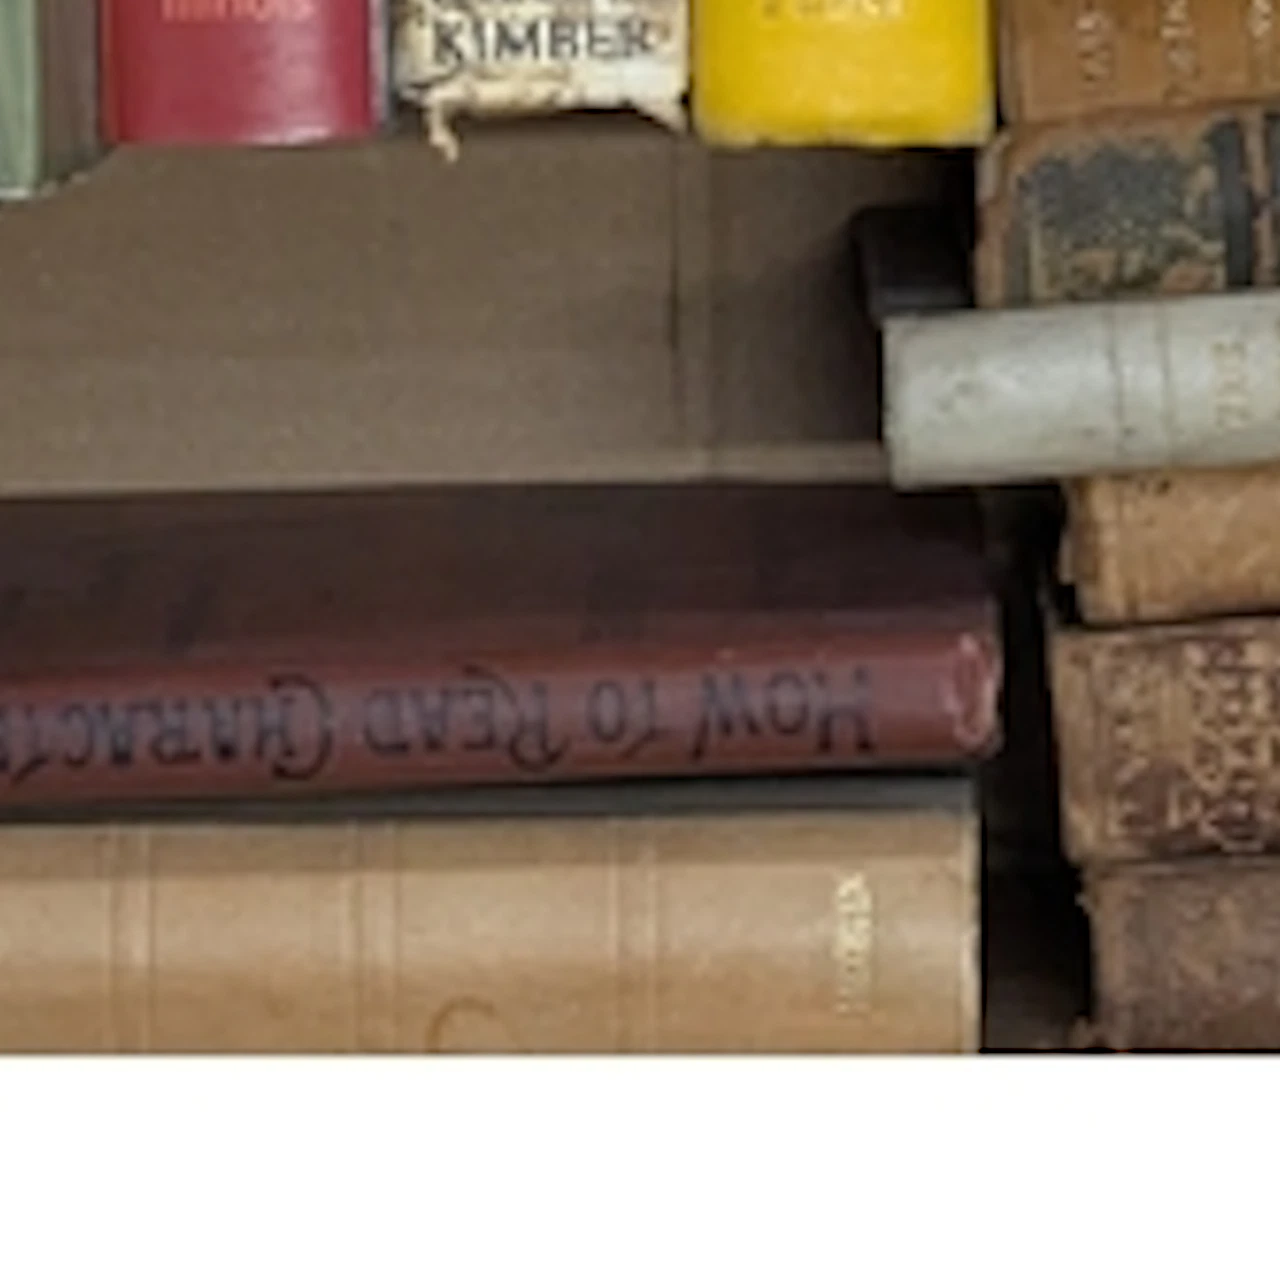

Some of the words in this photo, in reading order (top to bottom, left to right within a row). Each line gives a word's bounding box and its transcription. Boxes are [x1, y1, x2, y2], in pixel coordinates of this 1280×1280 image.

[360, 664, 572, 774] READ
[581, 678, 662, 760] TO
[689, 663, 877, 758] HOW
